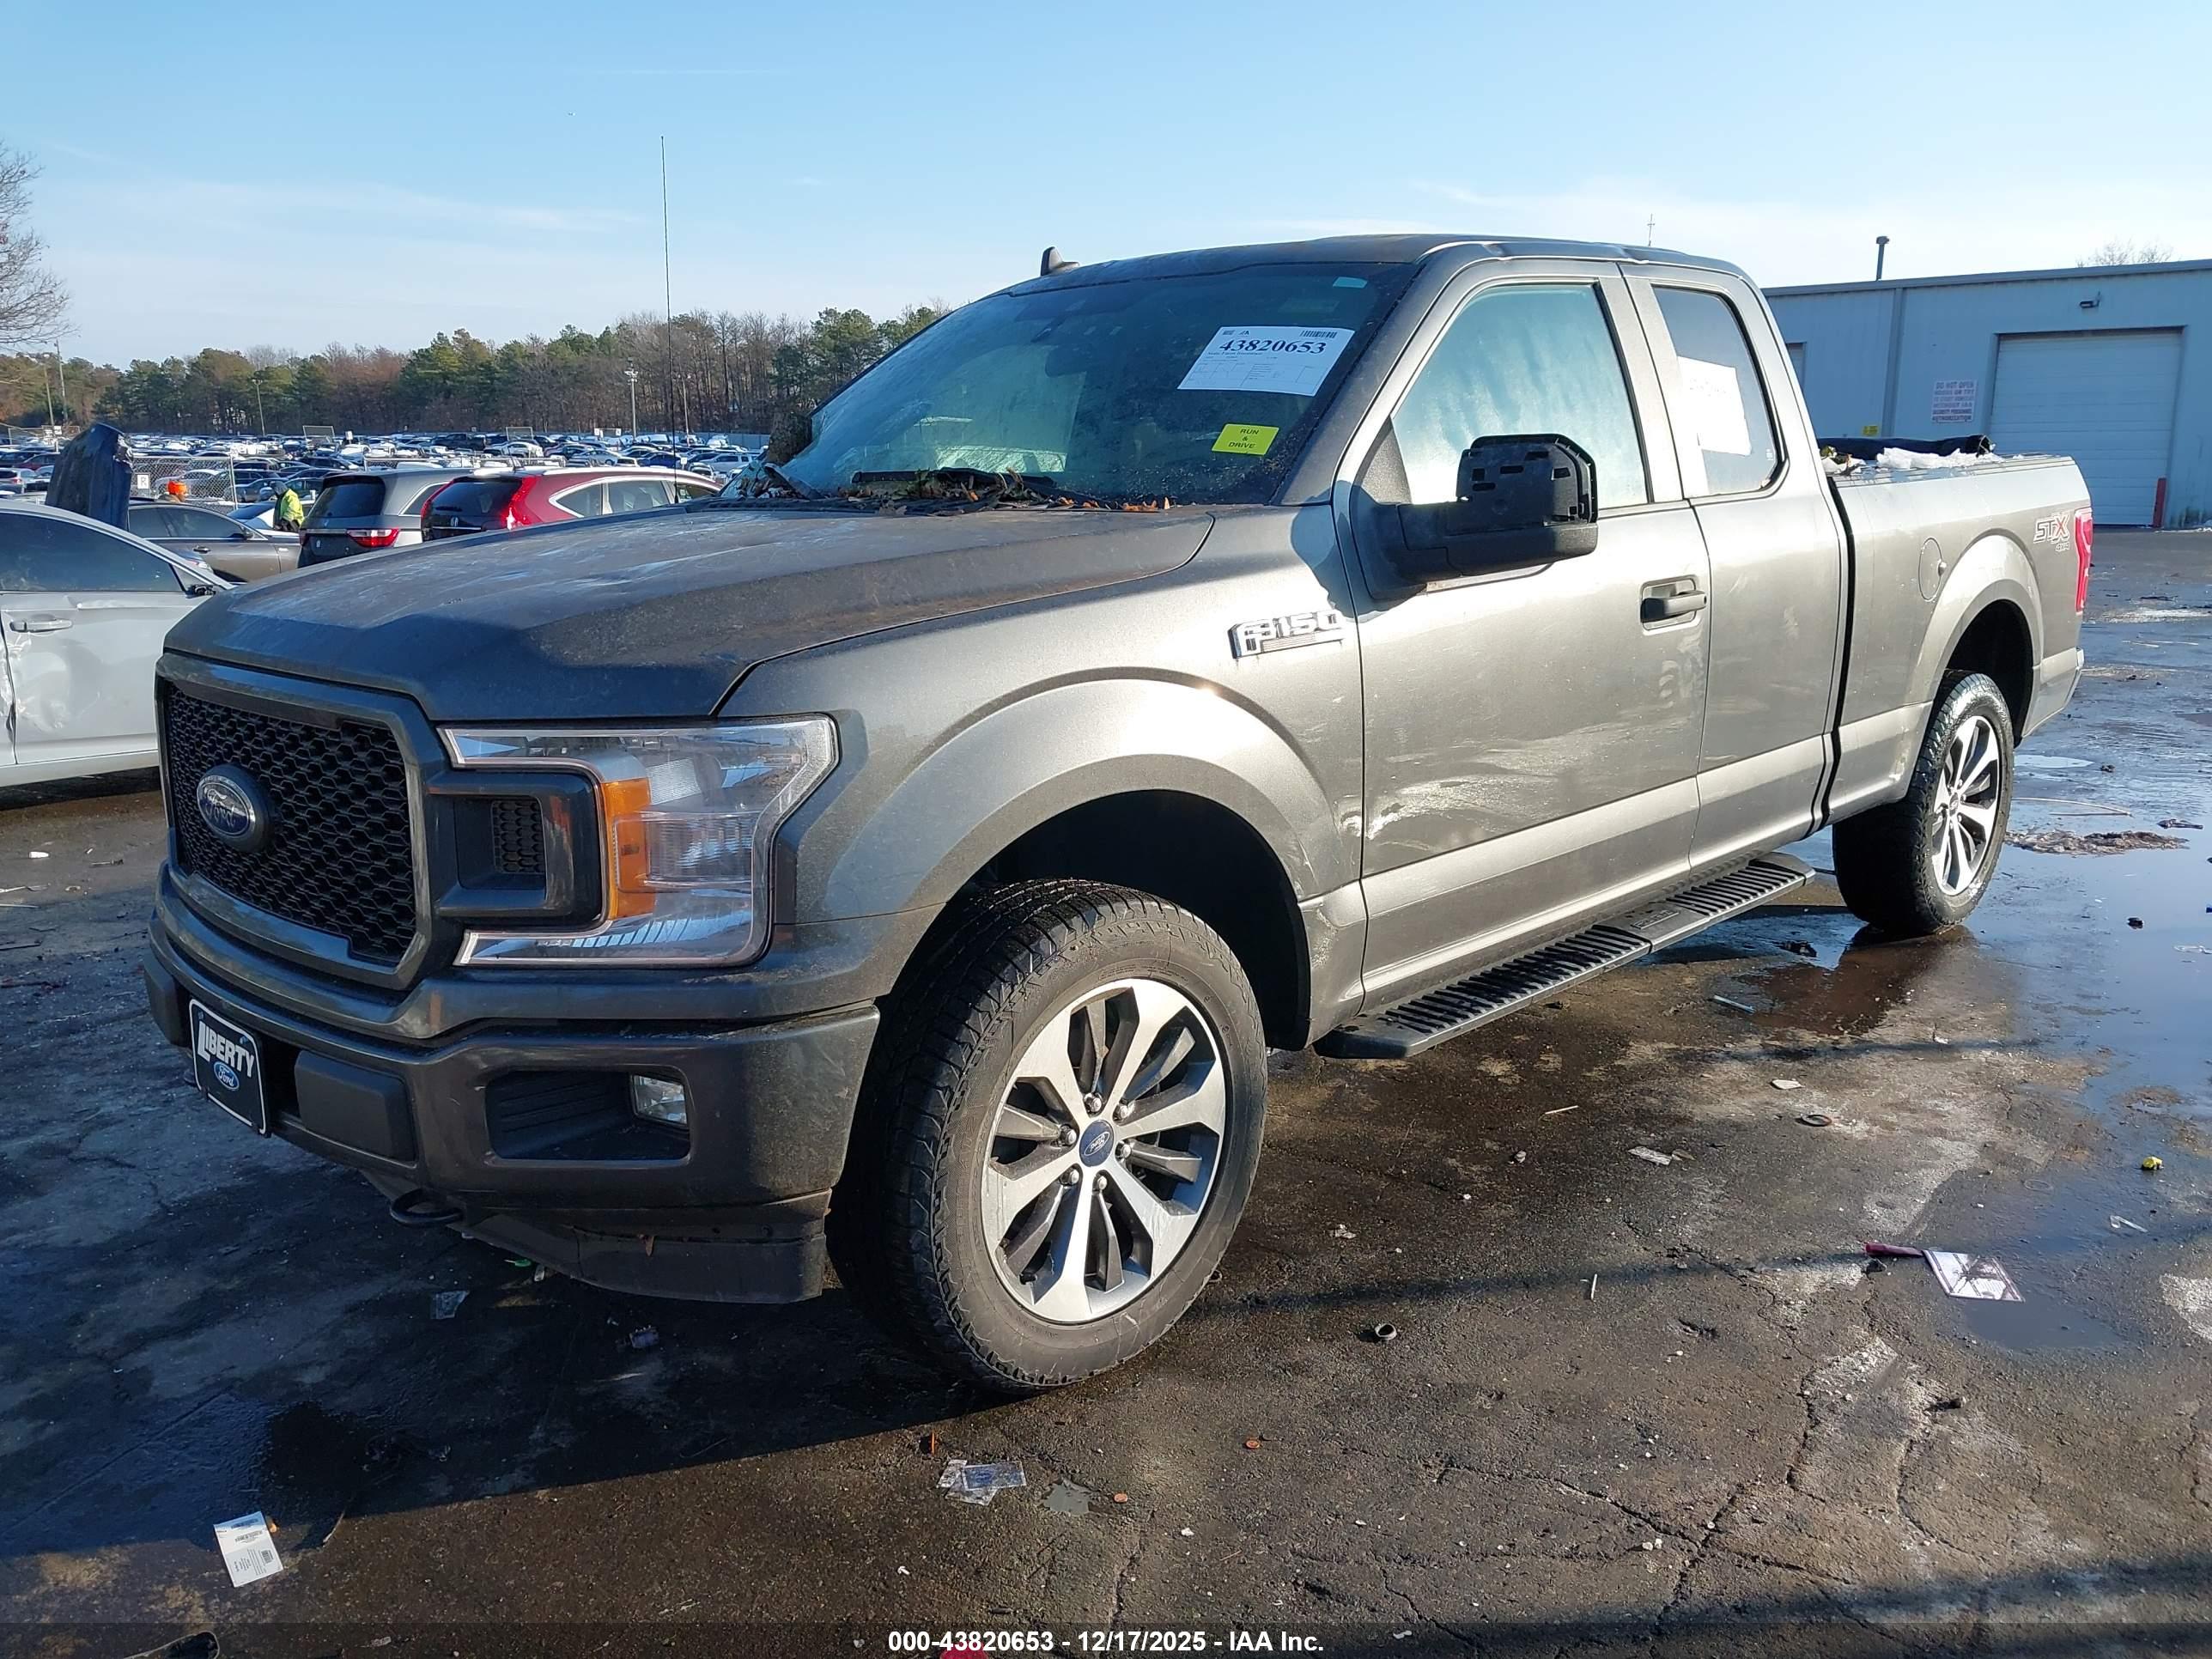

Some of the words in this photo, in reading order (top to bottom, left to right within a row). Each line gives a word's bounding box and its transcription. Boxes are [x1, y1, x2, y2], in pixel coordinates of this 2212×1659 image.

[1219, 339, 1327, 354] 43820653
[2033, 514, 2069, 544] STX
[198, 1020, 255, 1078] LIBERTY
[217, 1064, 236, 1087] Ford
